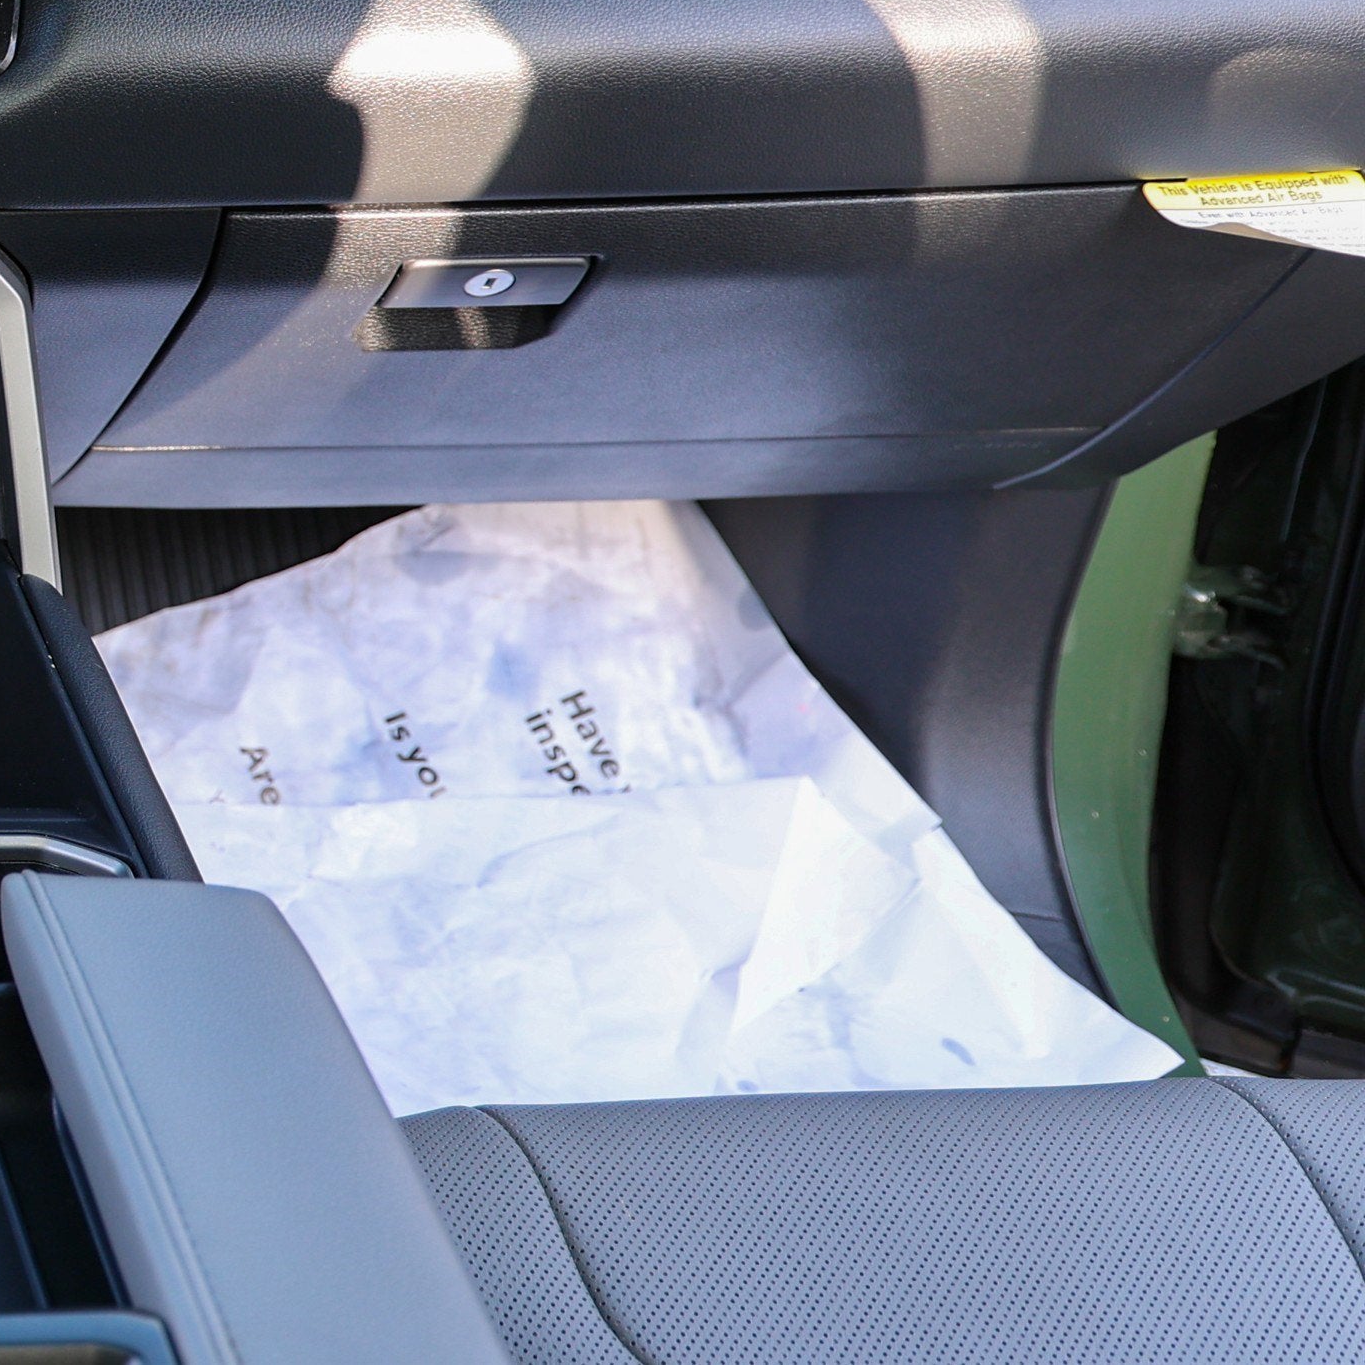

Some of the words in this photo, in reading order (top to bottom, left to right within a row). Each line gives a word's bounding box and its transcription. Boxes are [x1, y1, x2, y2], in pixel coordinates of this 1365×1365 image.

[1158, 186, 1189, 196] This
[1189, 179, 1237, 195] Vehicle
[1256, 176, 1317, 194] Equipped
[1320, 173, 1348, 185] with
[1200, 194, 1265, 206] Advanced
[1268, 191, 1287, 202] Air
[1289, 190, 1323, 204] Bags
[384, 711, 412, 742] Is
[561, 690, 621, 780] Have
[239, 745, 282, 806] Are
